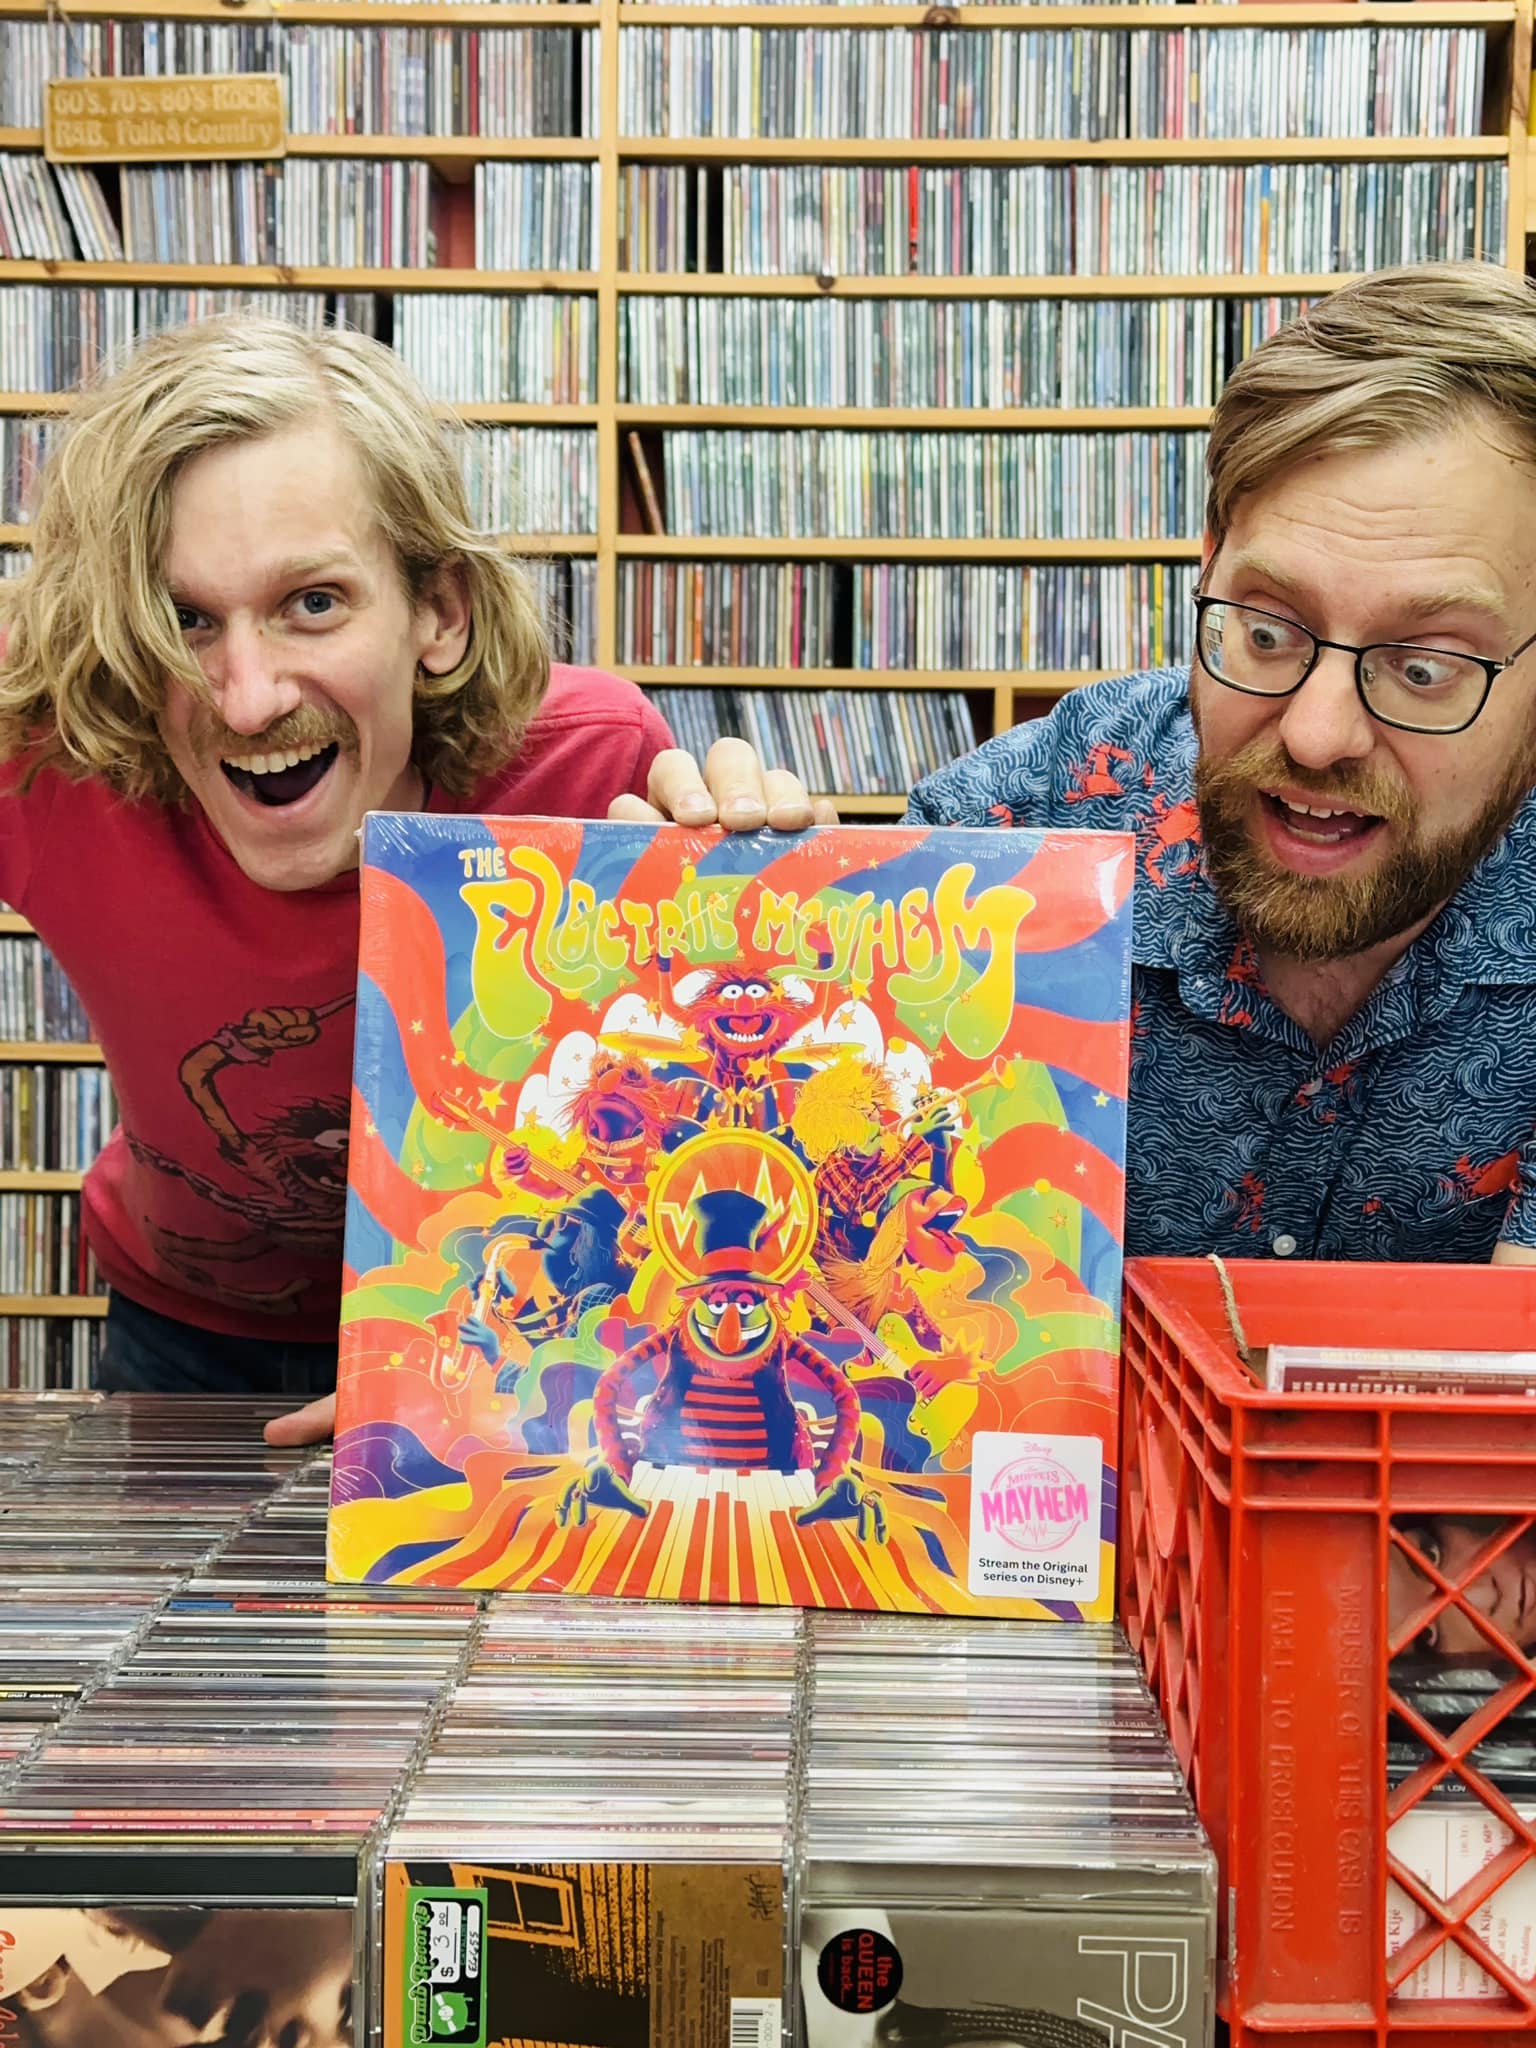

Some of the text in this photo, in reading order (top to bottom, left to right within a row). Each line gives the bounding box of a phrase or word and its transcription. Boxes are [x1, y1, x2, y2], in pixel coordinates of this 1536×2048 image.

[459, 848, 506, 878] THE
[460, 845, 1038, 1061] ELECTRIC MAYHEM
[980, 1484, 1089, 1533] MAYHEM
[979, 1558, 1088, 1574] Stream the Original
[1020, 1575, 1035, 1584] on
[1037, 1574, 1085, 1588] Disney+
[1338, 1909, 1363, 1935] IS
[433, 1934, 450, 1949] 3
[411, 1904, 436, 2043] Dumb Records
[440, 1966, 455, 1978] $
[857, 1932, 875, 2009] QUEEN
[876, 1956, 893, 1987] the
